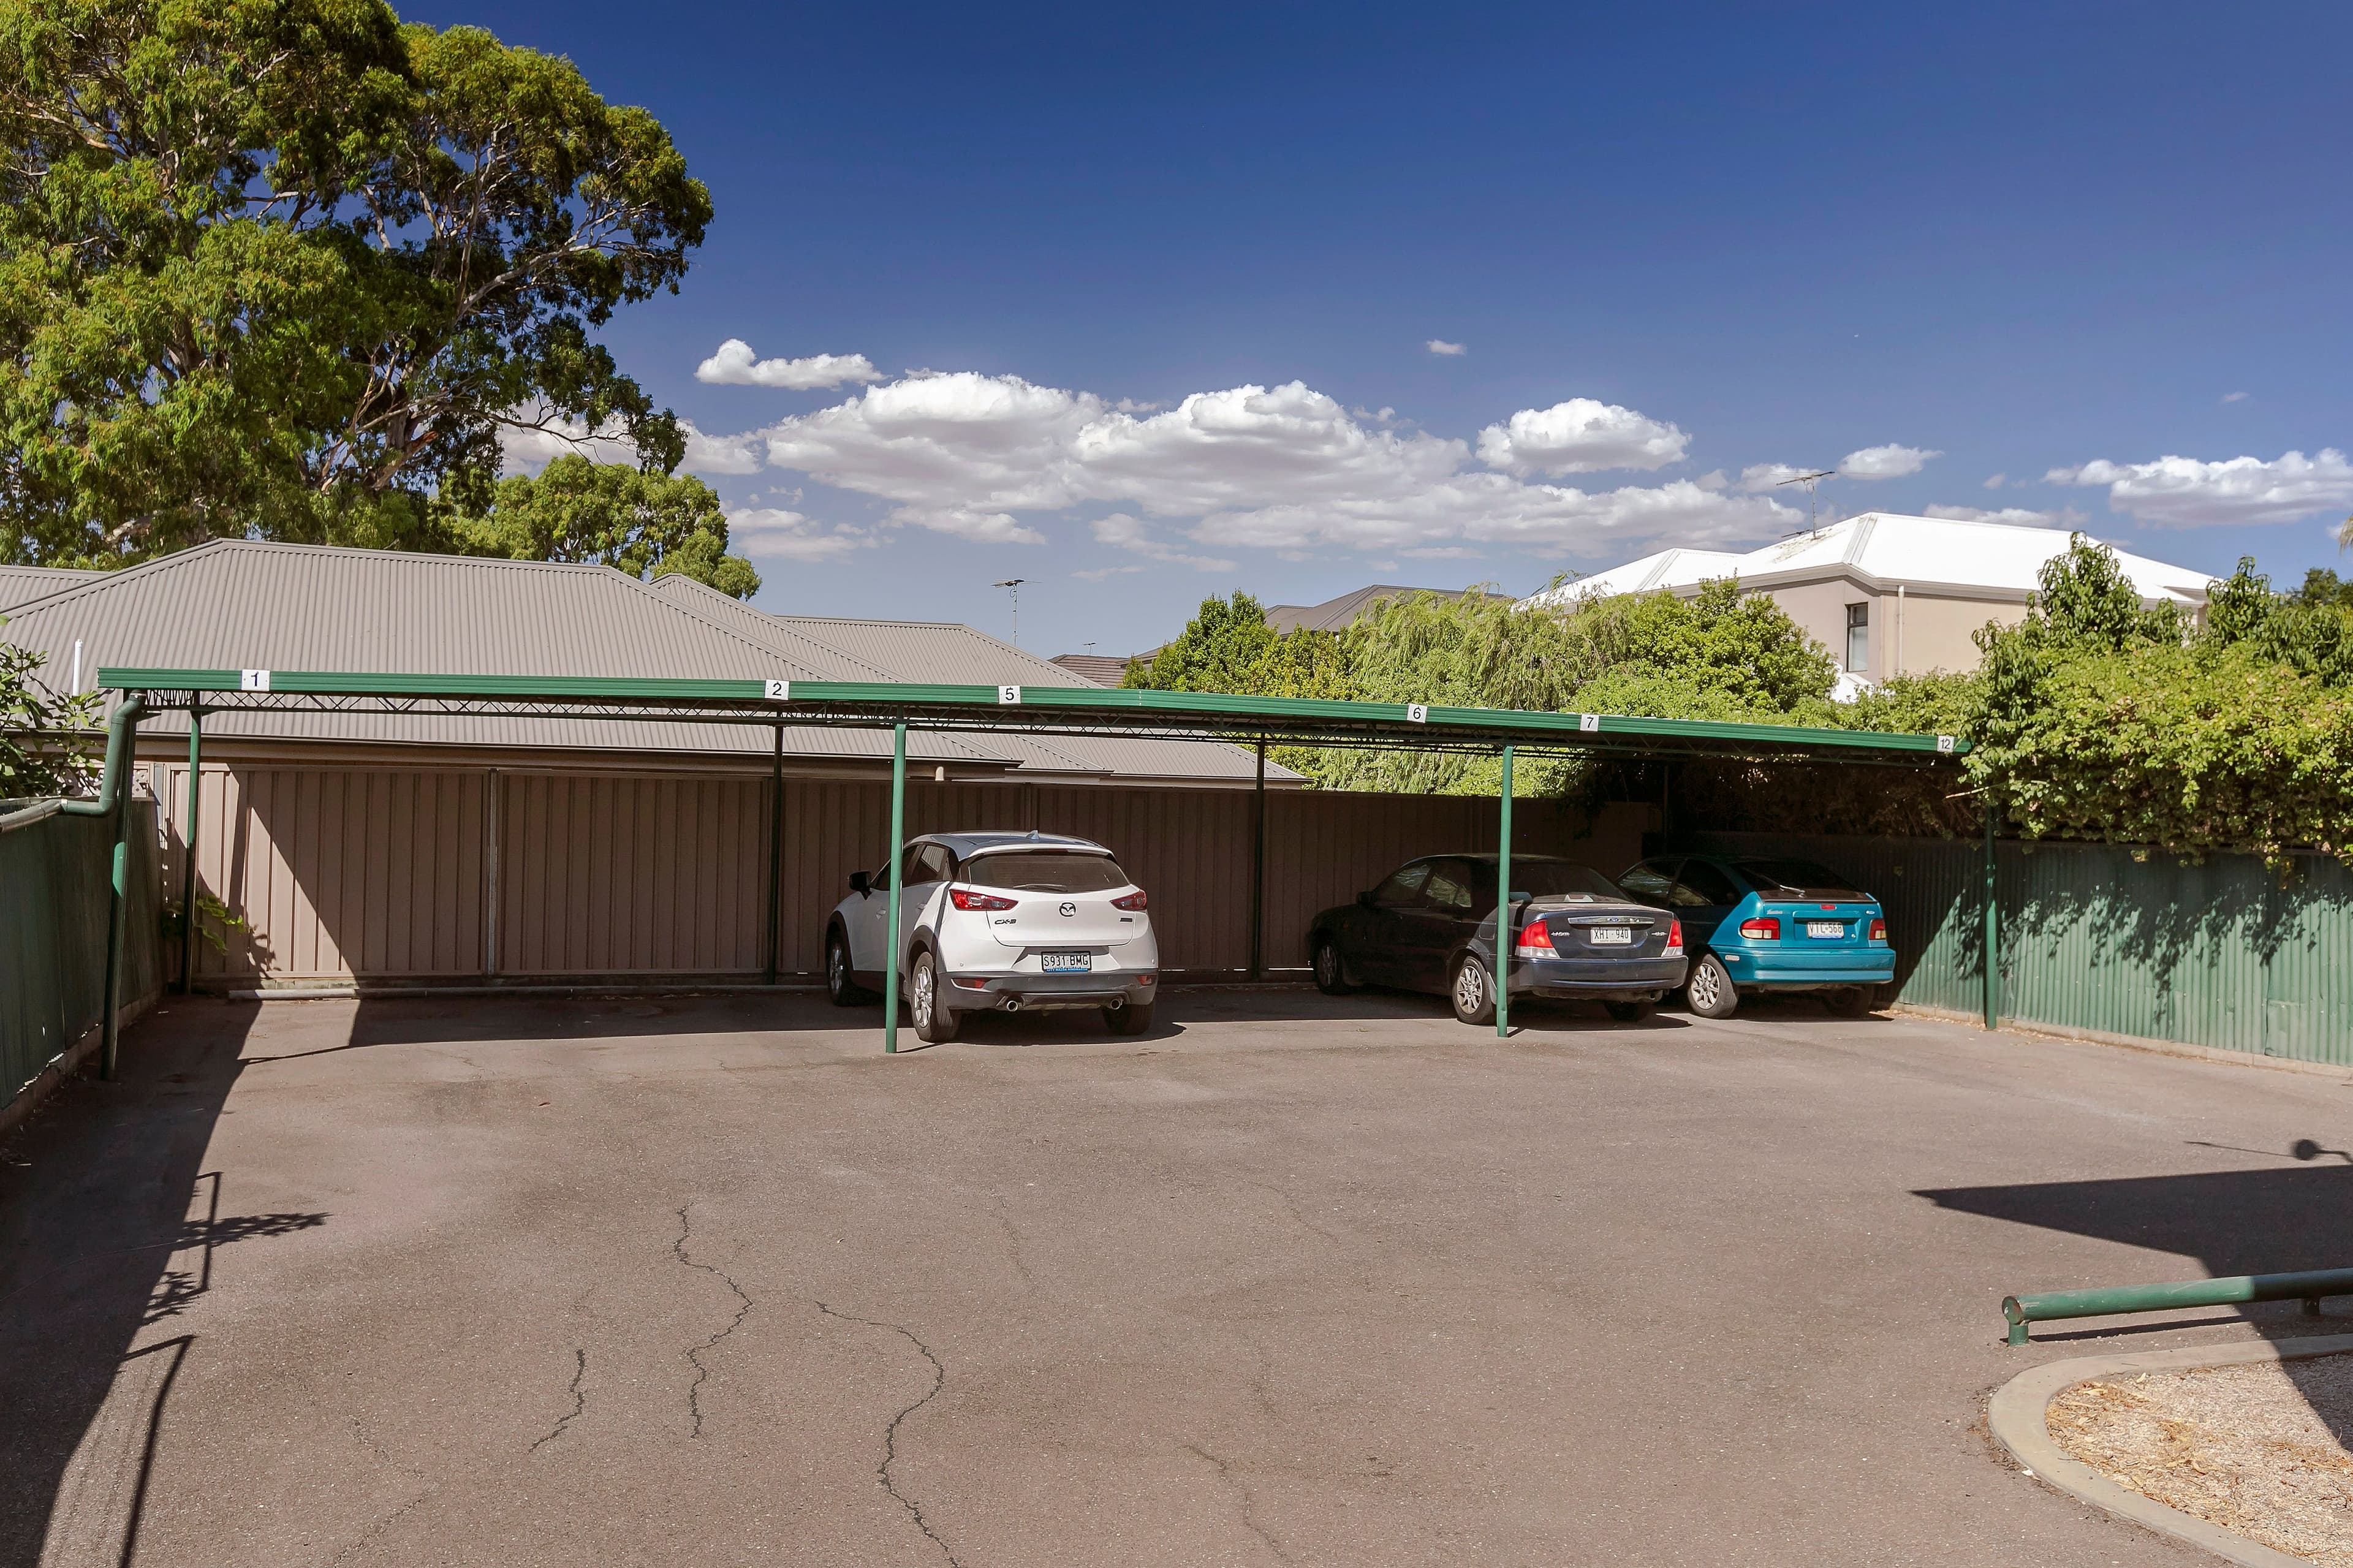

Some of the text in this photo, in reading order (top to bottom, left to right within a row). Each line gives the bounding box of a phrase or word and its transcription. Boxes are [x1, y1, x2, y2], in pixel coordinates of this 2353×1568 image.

[251, 672, 258, 686] 1
[772, 682, 782, 696] 2
[1005, 687, 1014, 701] 5
[1413, 706, 1421, 719] 6
[1586, 717, 1594, 728] 7
[1941, 740, 1950, 749] 12
